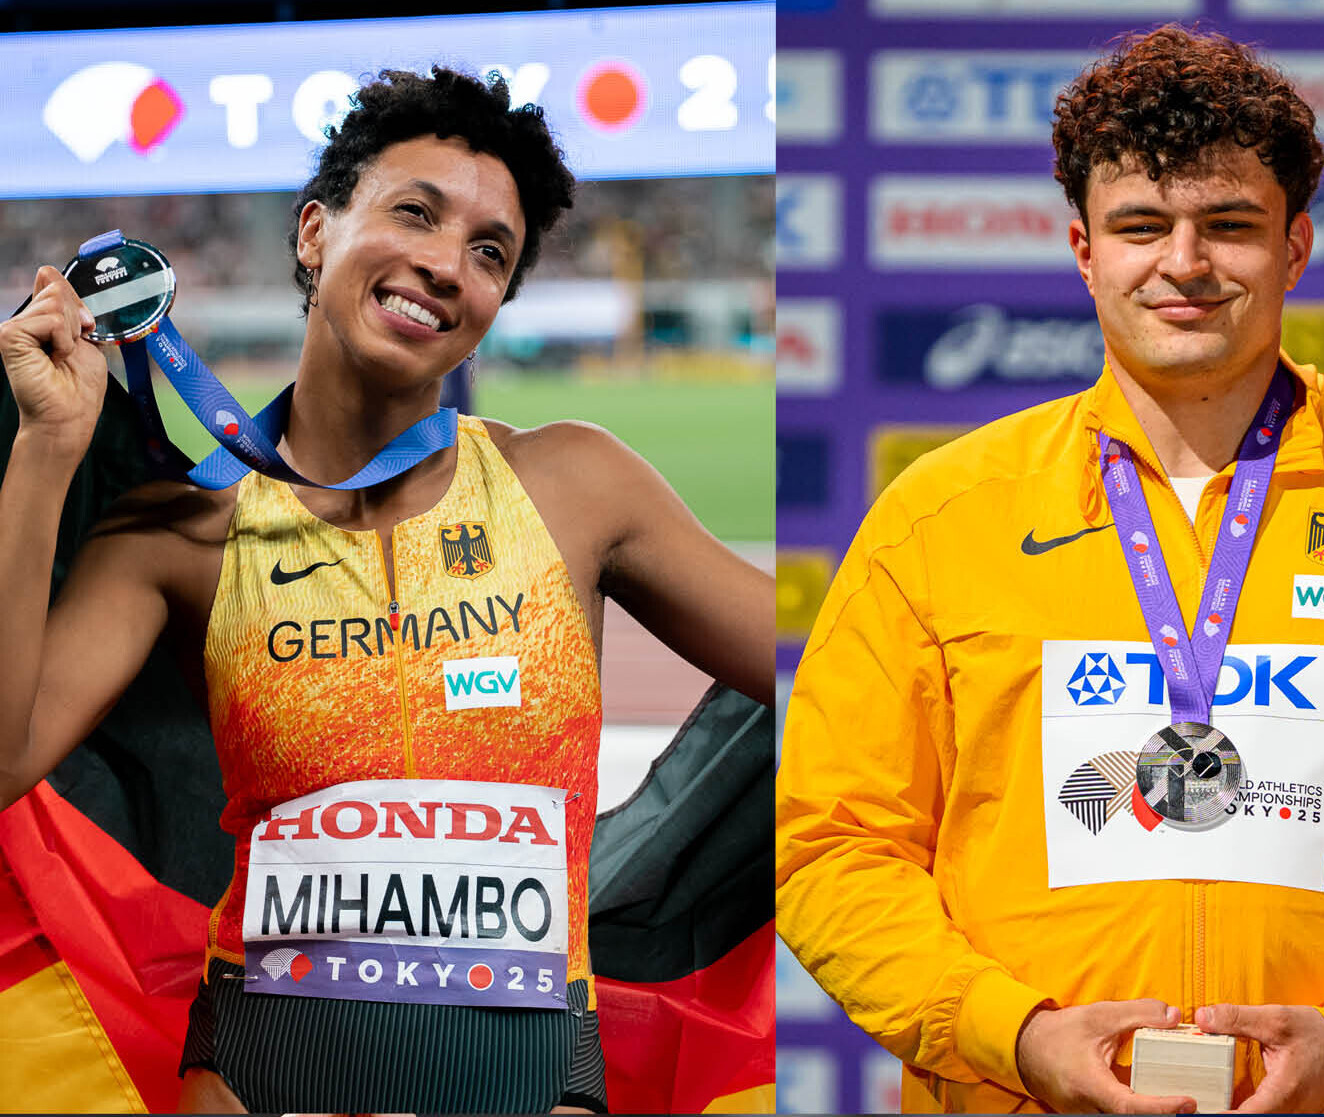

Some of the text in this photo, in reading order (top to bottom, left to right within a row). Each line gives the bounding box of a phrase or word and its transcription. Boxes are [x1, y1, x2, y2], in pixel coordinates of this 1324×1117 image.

[267, 593, 524, 662] GERMANY
[446, 668, 519, 697] WGV
[1126, 652, 1317, 710] TDK
[1233, 791, 1322, 811] MPIONSHIPS
[1258, 780, 1323, 797] ATHLETICS
[258, 800, 558, 846] HONDA
[262, 873, 552, 942] MIHAMBO
